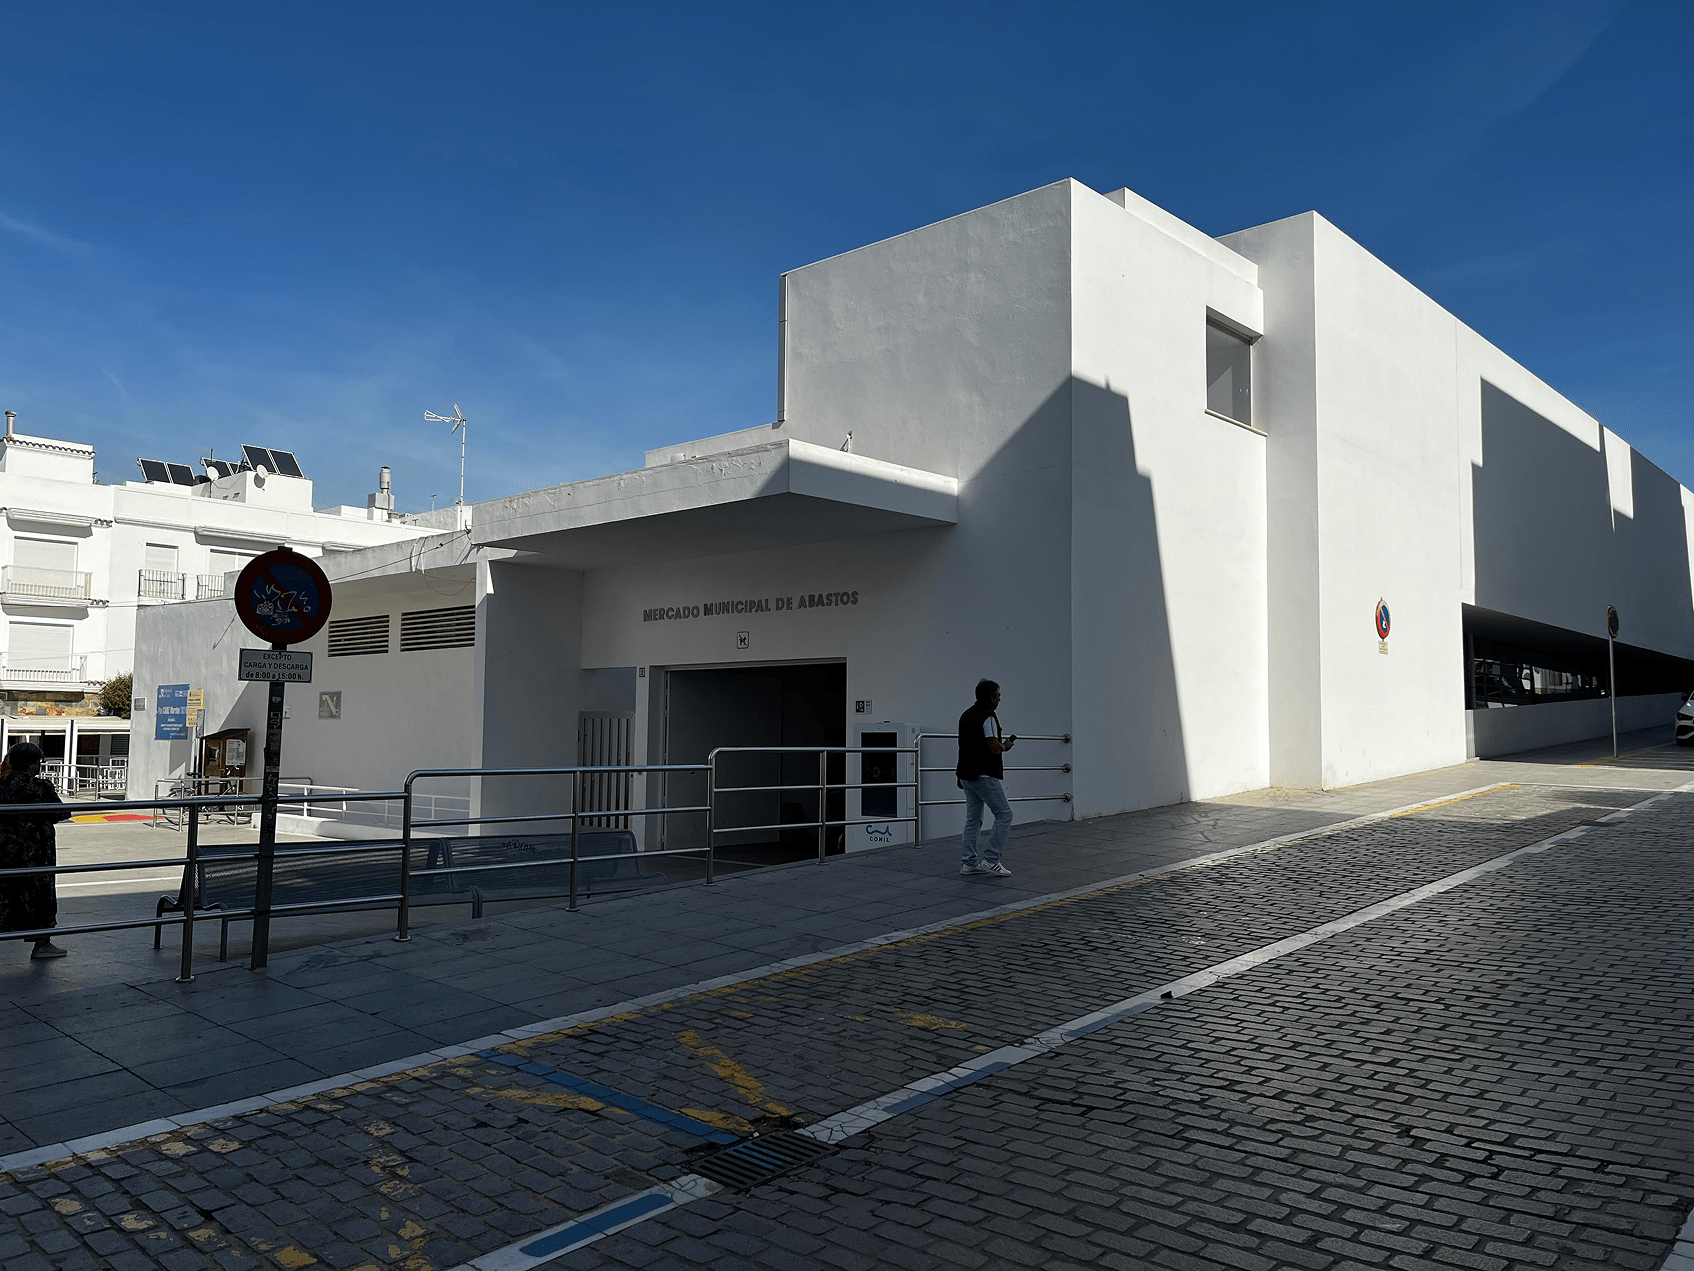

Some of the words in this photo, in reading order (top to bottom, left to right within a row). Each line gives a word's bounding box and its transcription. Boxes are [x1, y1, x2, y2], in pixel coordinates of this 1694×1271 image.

[643, 605, 700, 622] MERCADO
[704, 598, 771, 616] MUNICIPAL
[776, 597, 793, 611] DE
[797, 591, 859, 609] ABASTOS
